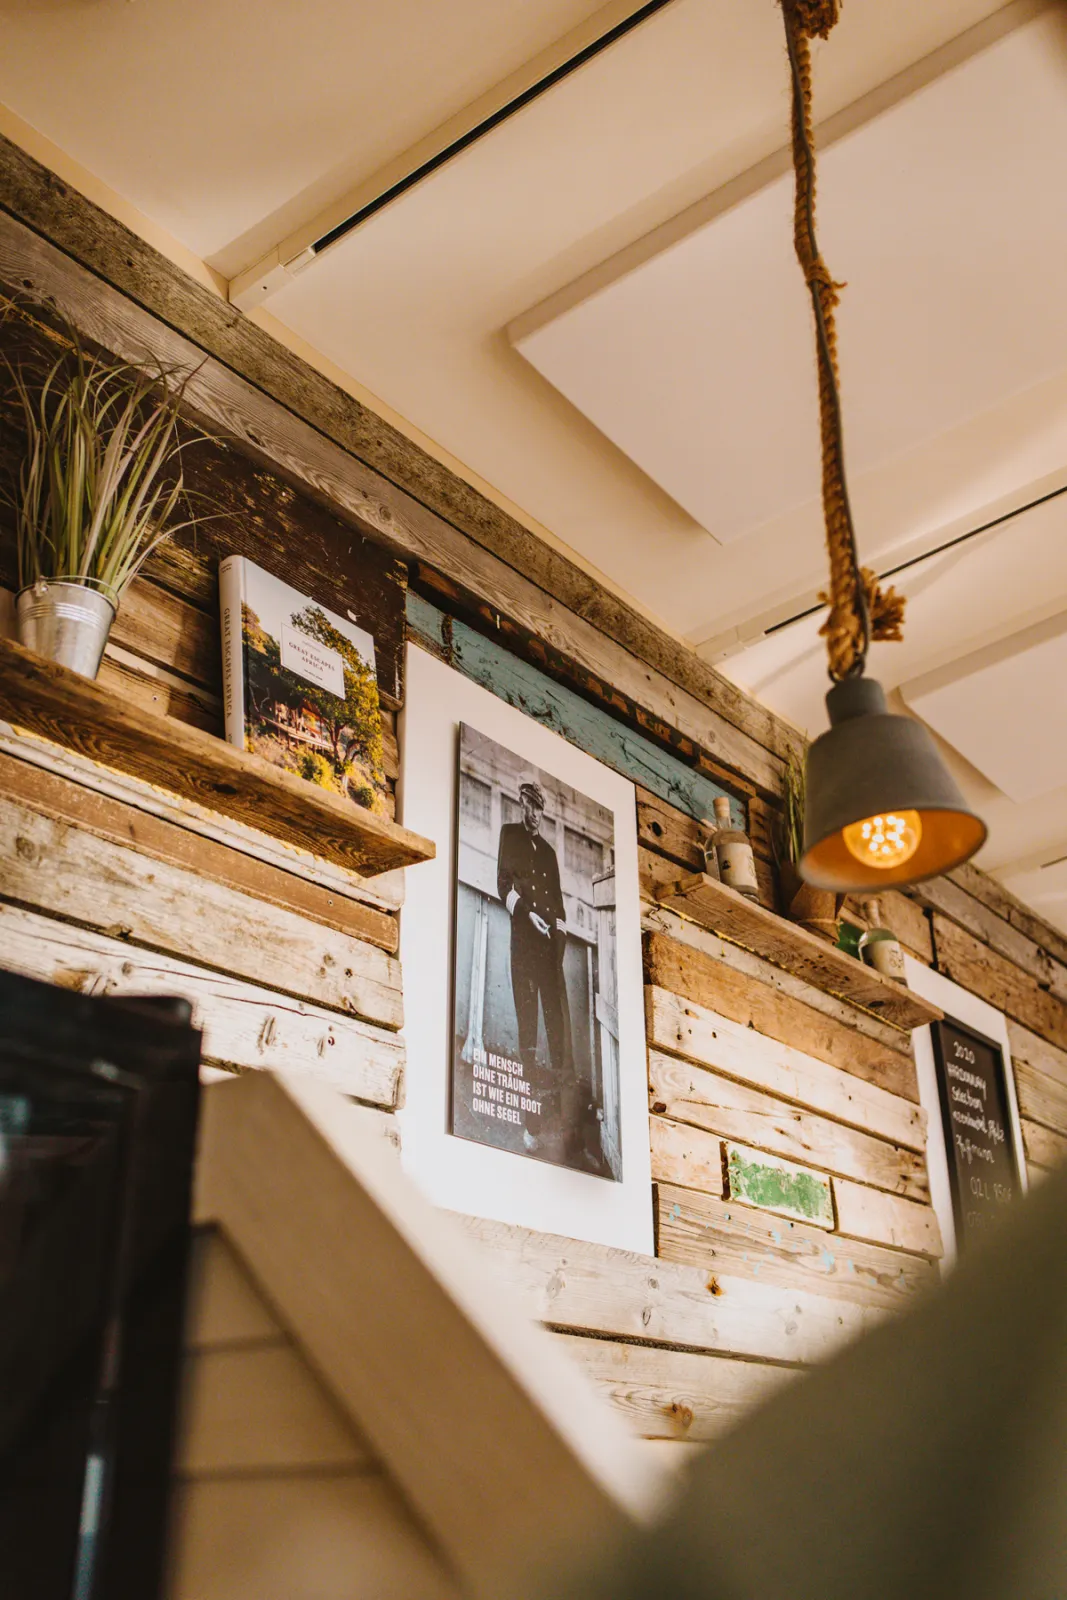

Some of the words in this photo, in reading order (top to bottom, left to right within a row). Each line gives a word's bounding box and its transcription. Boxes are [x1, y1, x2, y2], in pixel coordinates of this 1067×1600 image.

[223, 606, 231, 637] GREAT
[289, 642, 308, 656] GREAT
[310, 653, 335, 671] ESCAPES
[302, 656, 324, 672] AFRICA
[473, 1048, 487, 1065] EIN
[489, 1052, 523, 1077] MENSCH
[953, 1041, 975, 1064] 2020
[473, 1064, 495, 1083] OHNE
[497, 1072, 531, 1096] TRÄUME
[473, 1080, 487, 1097] IST
[488, 1086, 504, 1103] WIE
[506, 1091, 519, 1108] EIN
[521, 1097, 542, 1115] BOOT
[473, 1098, 495, 1117] OHNE
[497, 1105, 522, 1125] SEGEL
